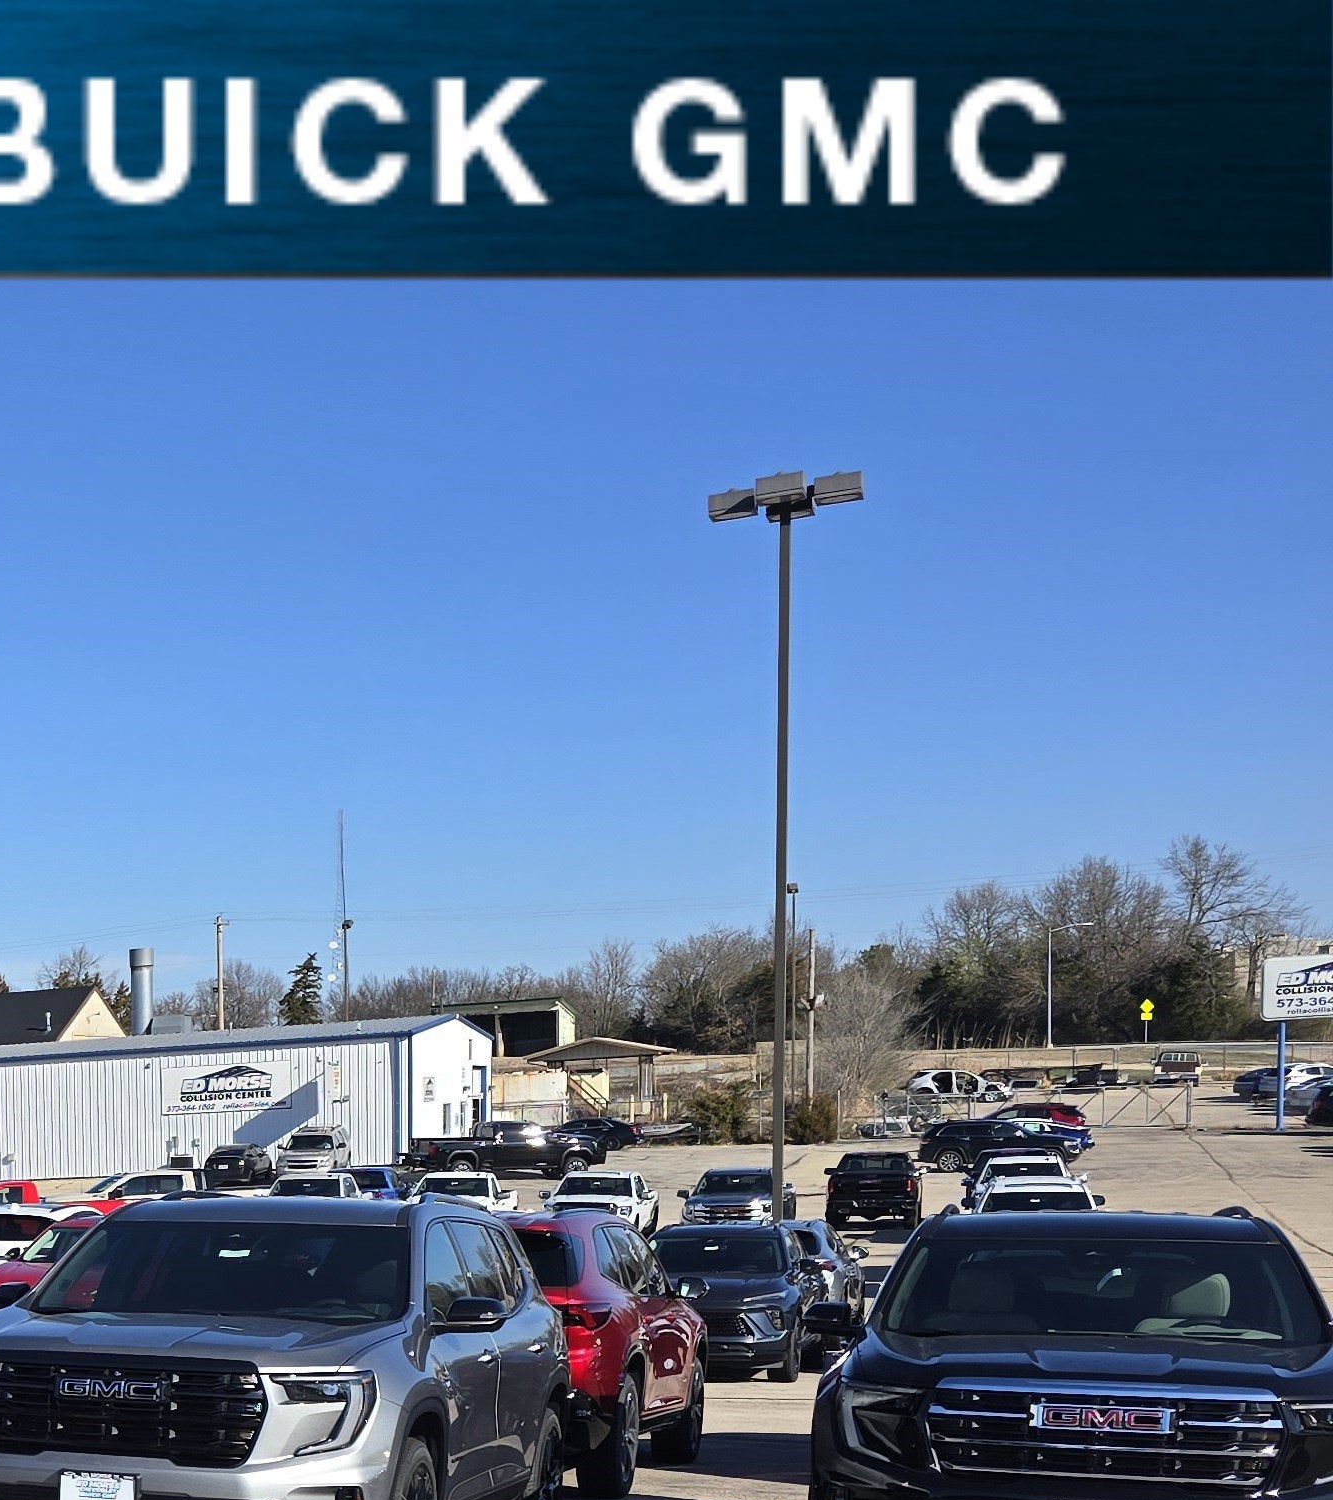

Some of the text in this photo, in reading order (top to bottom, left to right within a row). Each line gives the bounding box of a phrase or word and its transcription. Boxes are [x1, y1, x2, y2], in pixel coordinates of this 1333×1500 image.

[1277, 972, 1307, 987] ED
[181, 1074, 272, 1094] ED MORSE
[180, 1091, 272, 1102] COLLISION CENTER
[59, 1378, 158, 1400] GMC
[1043, 1407, 1163, 1430] GMC
